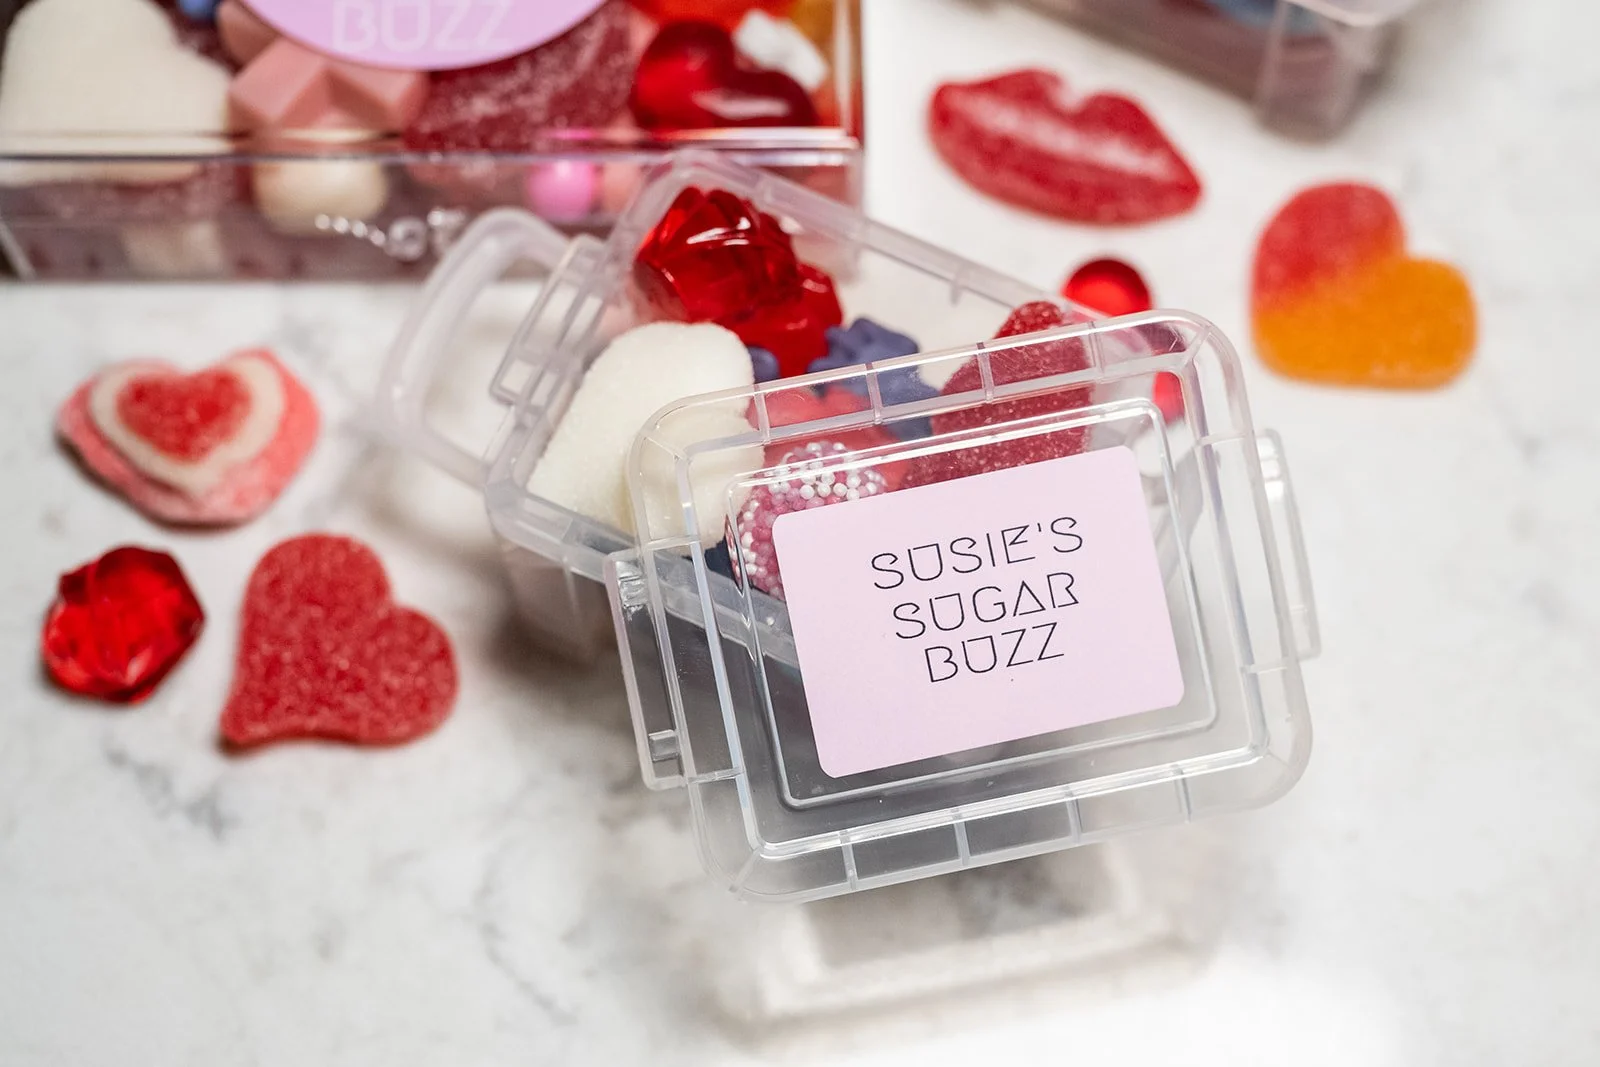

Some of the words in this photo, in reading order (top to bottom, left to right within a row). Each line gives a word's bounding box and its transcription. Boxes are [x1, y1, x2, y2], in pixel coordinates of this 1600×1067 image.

[332, 0, 514, 51] BUZZ
[871, 517, 1083, 590] SUSIE'S
[893, 572, 1080, 639] SUGAR
[924, 622, 1065, 683] BUZZ
